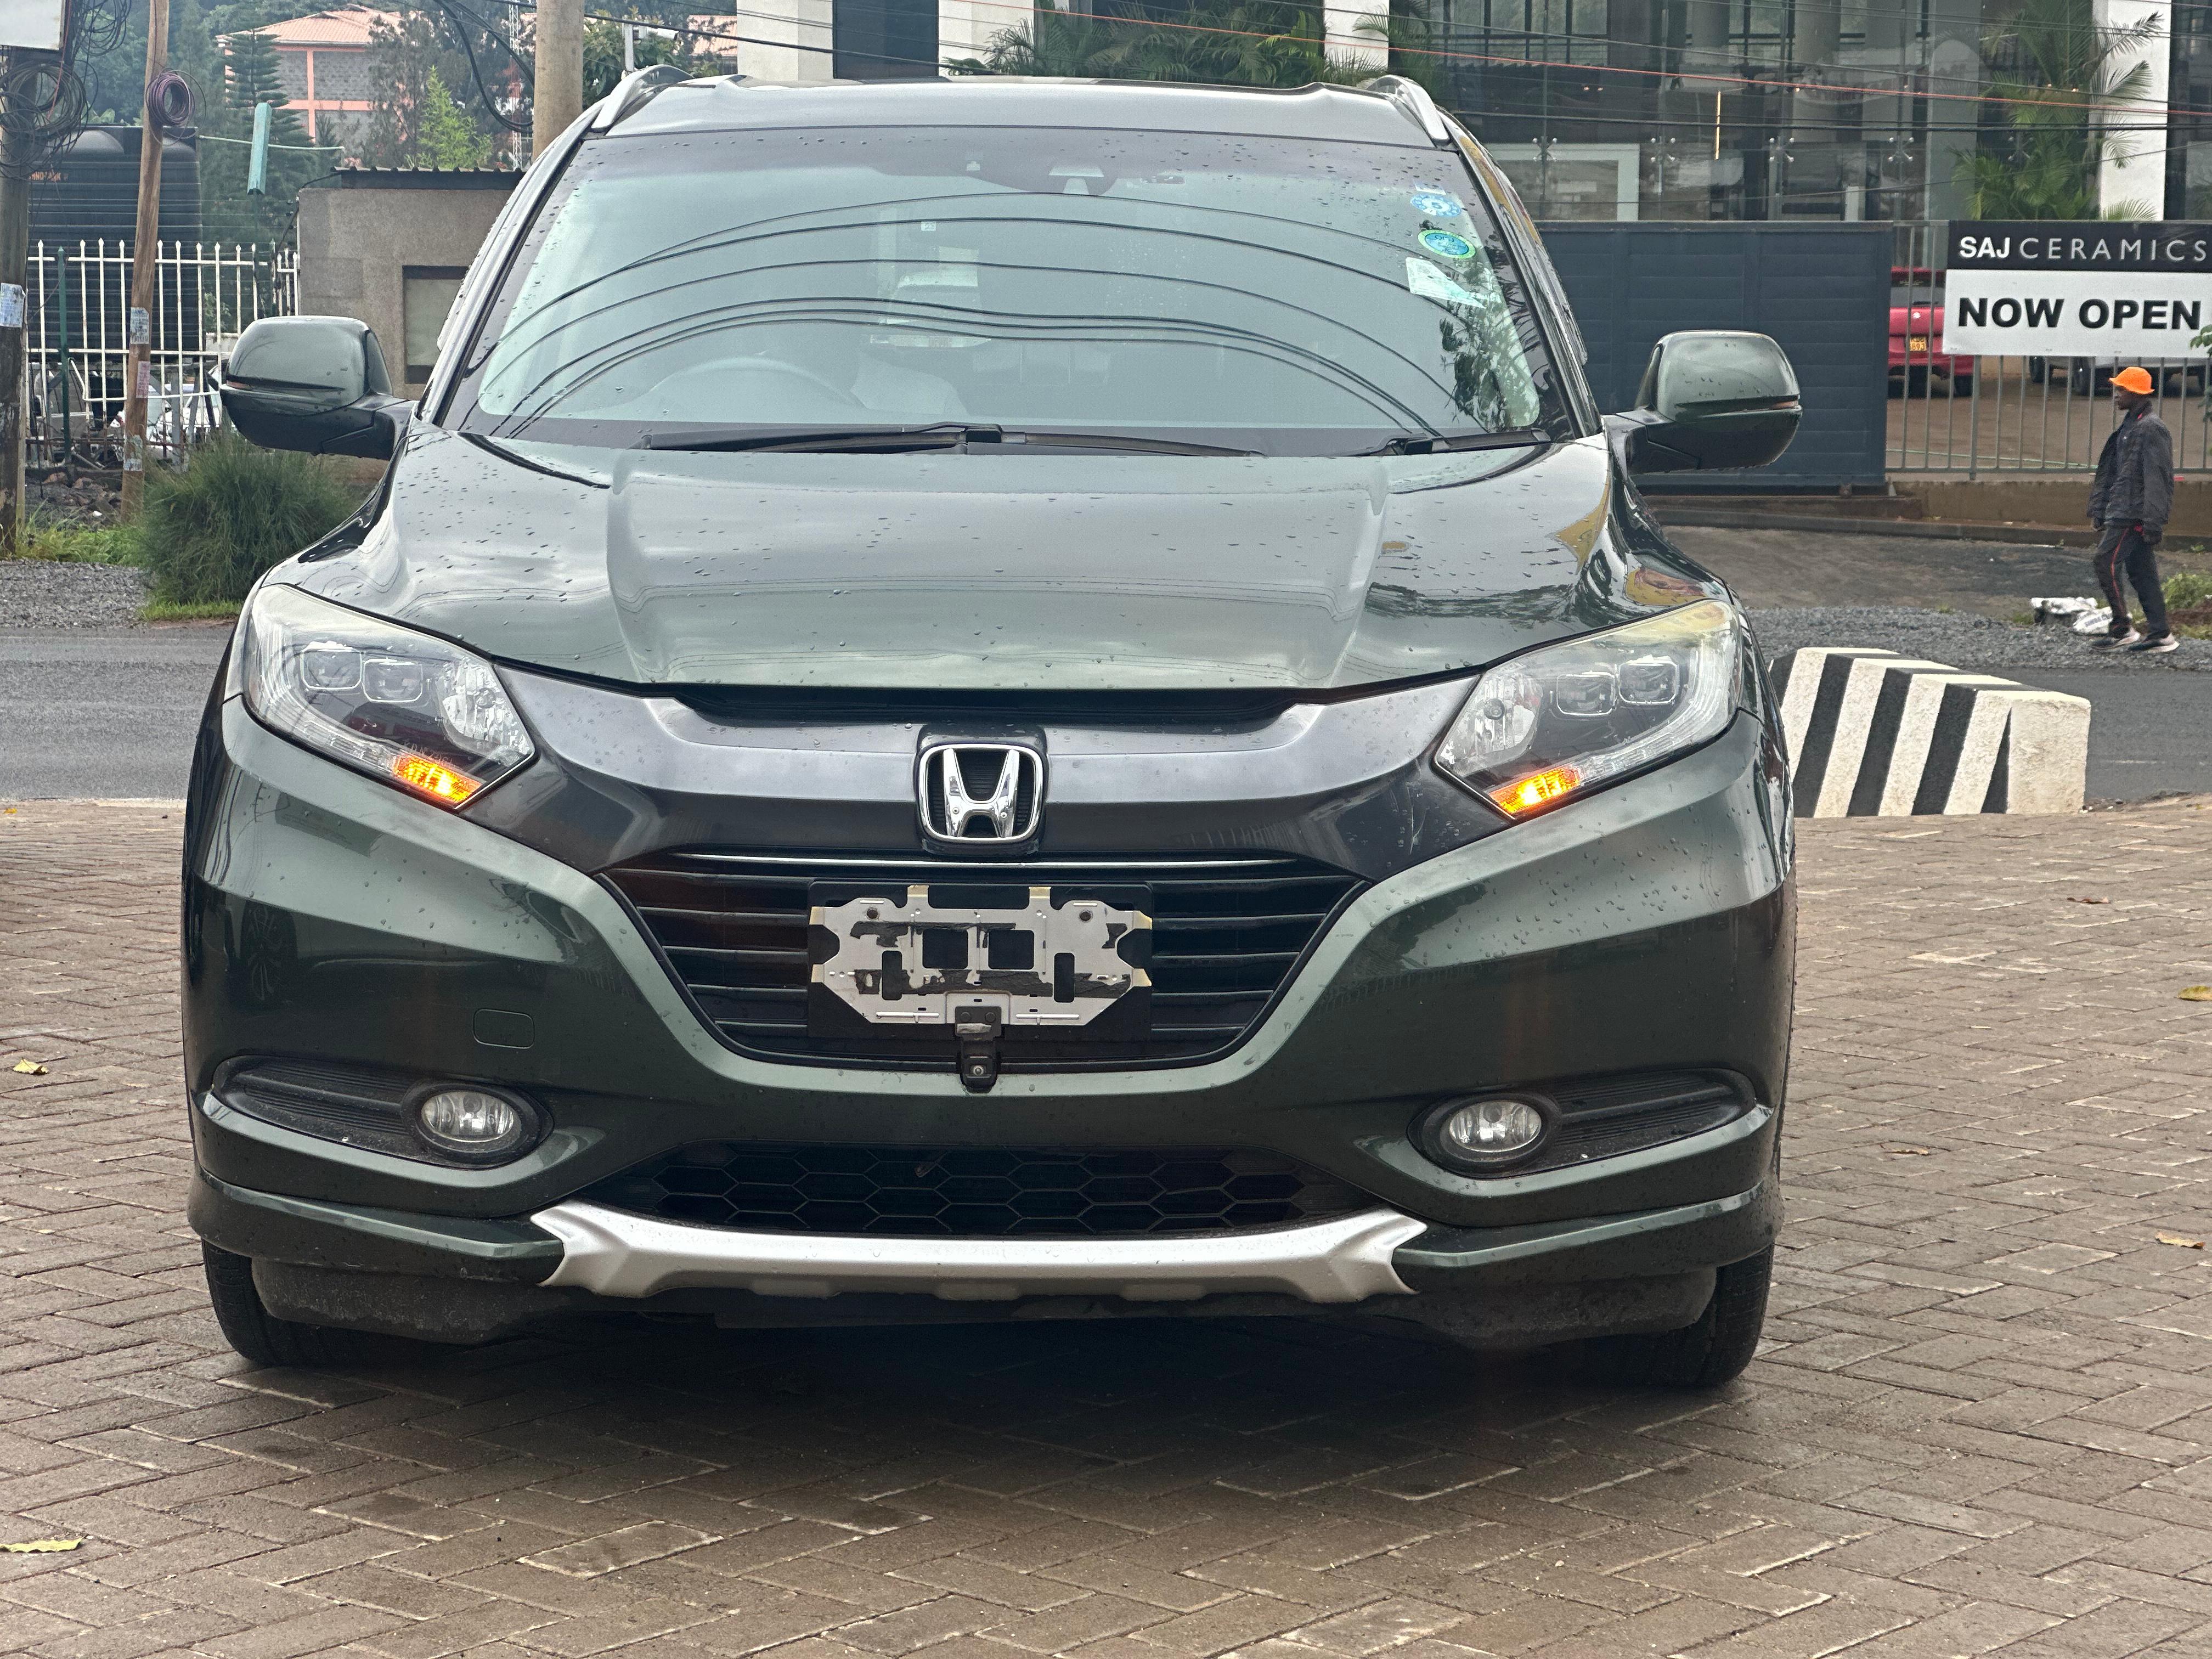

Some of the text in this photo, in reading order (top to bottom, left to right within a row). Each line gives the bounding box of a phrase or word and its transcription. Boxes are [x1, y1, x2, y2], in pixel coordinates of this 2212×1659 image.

[1960, 236, 2207, 262] SAJ CERAMICS
[1959, 297, 2202, 330] NOW OPEN
